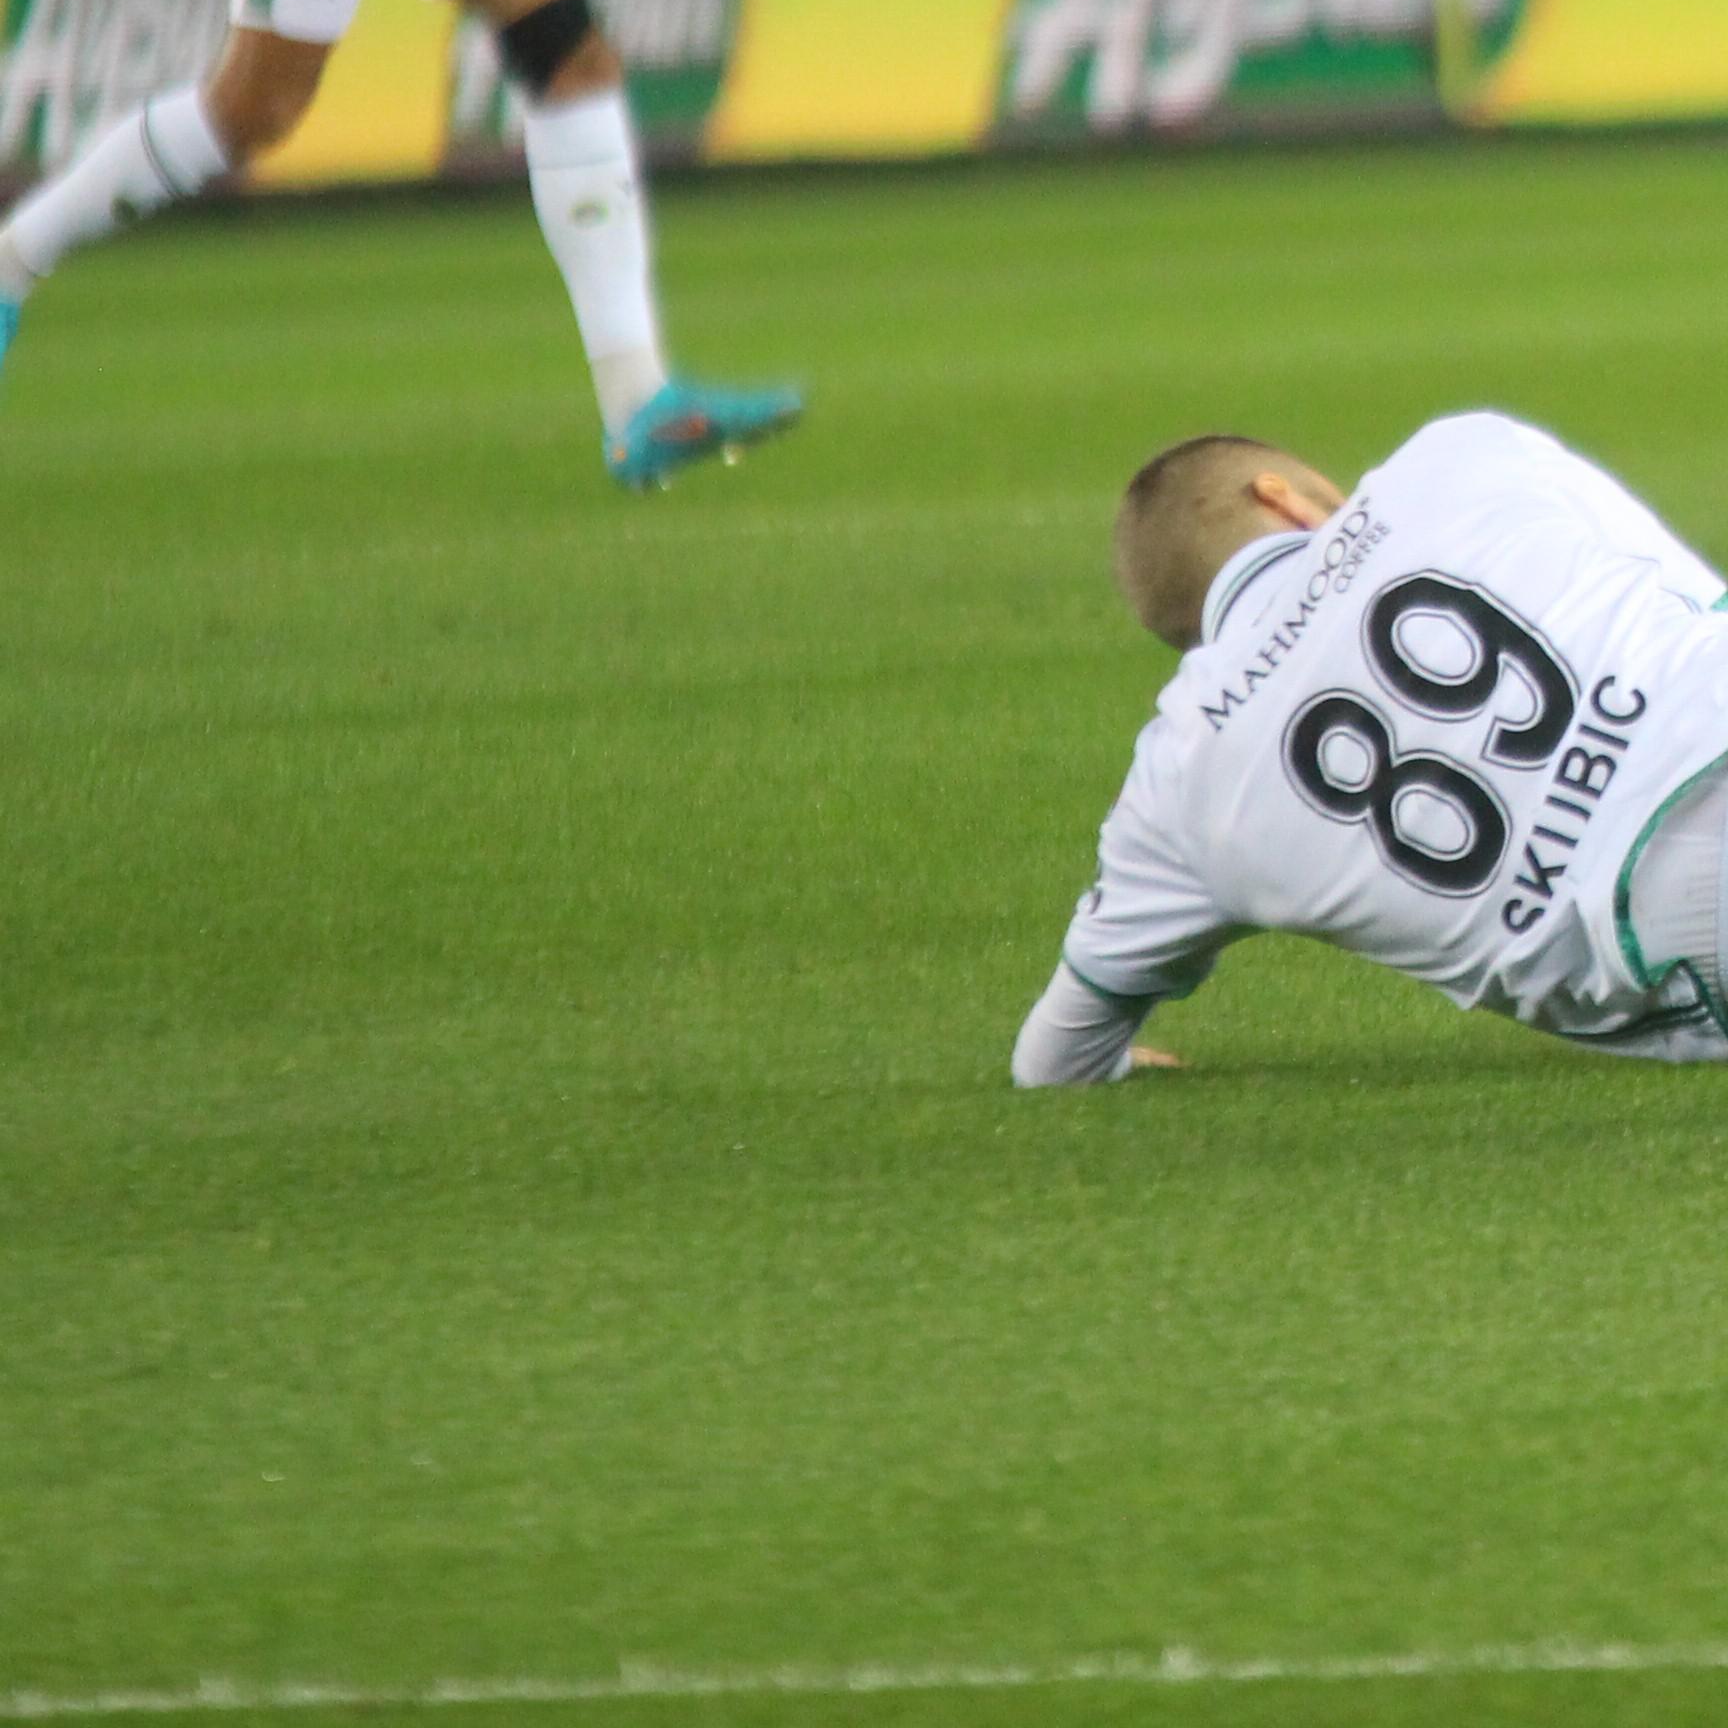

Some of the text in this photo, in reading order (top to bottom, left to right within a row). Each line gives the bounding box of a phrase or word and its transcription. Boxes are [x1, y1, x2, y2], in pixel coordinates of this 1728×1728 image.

[1200, 508, 1369, 733] MAHMOOD
[1333, 520, 1392, 595] COFFEE
[1281, 569, 1582, 900] 89
